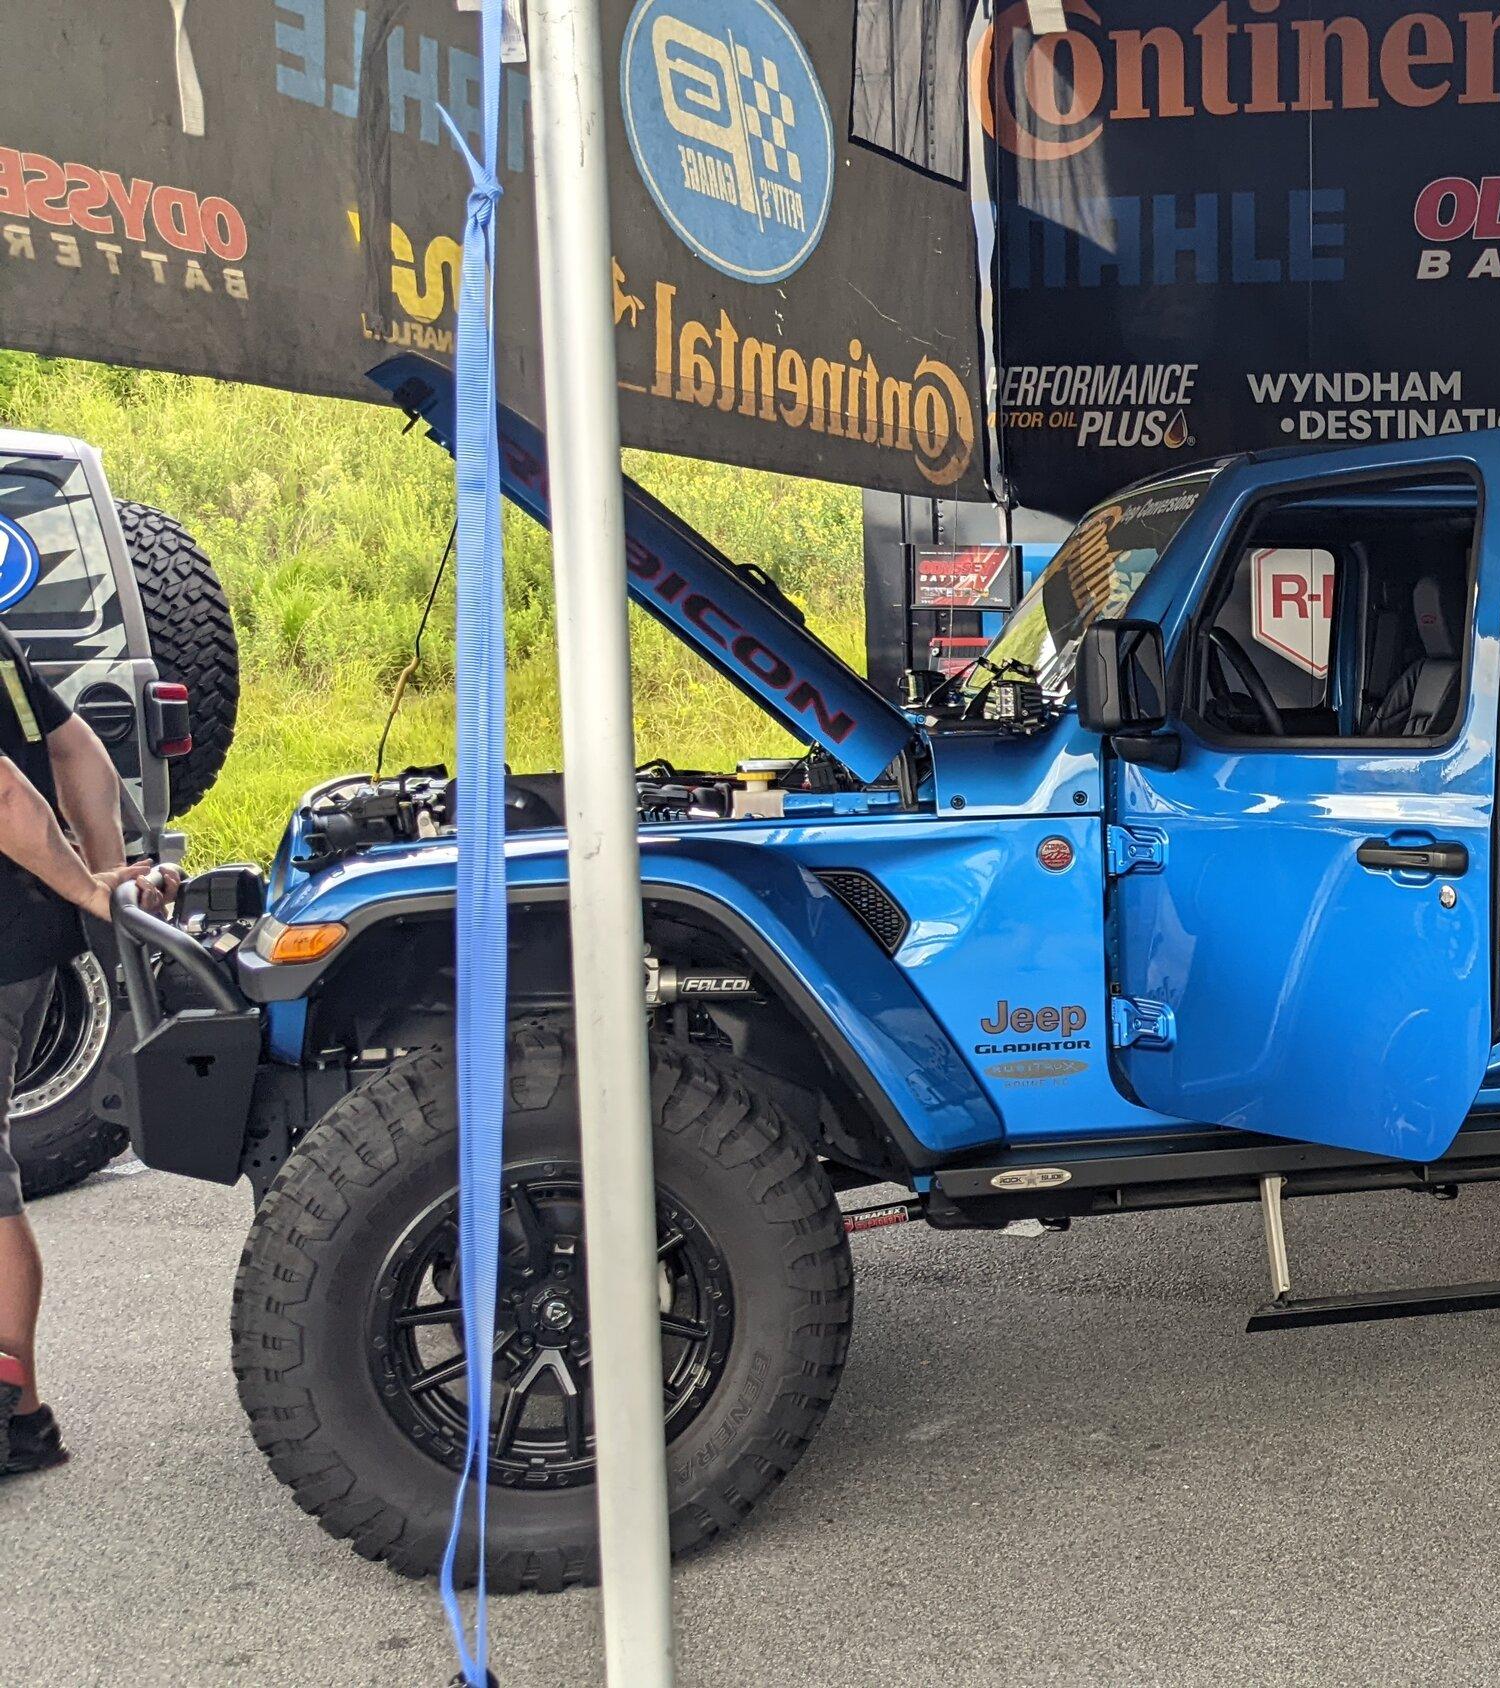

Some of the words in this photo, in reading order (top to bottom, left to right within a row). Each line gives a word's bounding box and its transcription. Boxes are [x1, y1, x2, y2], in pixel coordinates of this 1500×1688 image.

[986, 364, 1199, 406] PERFORMANCE
[1246, 371, 1462, 403] WYNDHAM
[1048, 411, 1078, 428] OIL
[1077, 410, 1167, 447] PLUS
[980, 999, 1087, 1038] Jeep
[974, 1040, 1091, 1055] GLADIATOR
[854, 1207, 901, 1222] TERAFLEX
